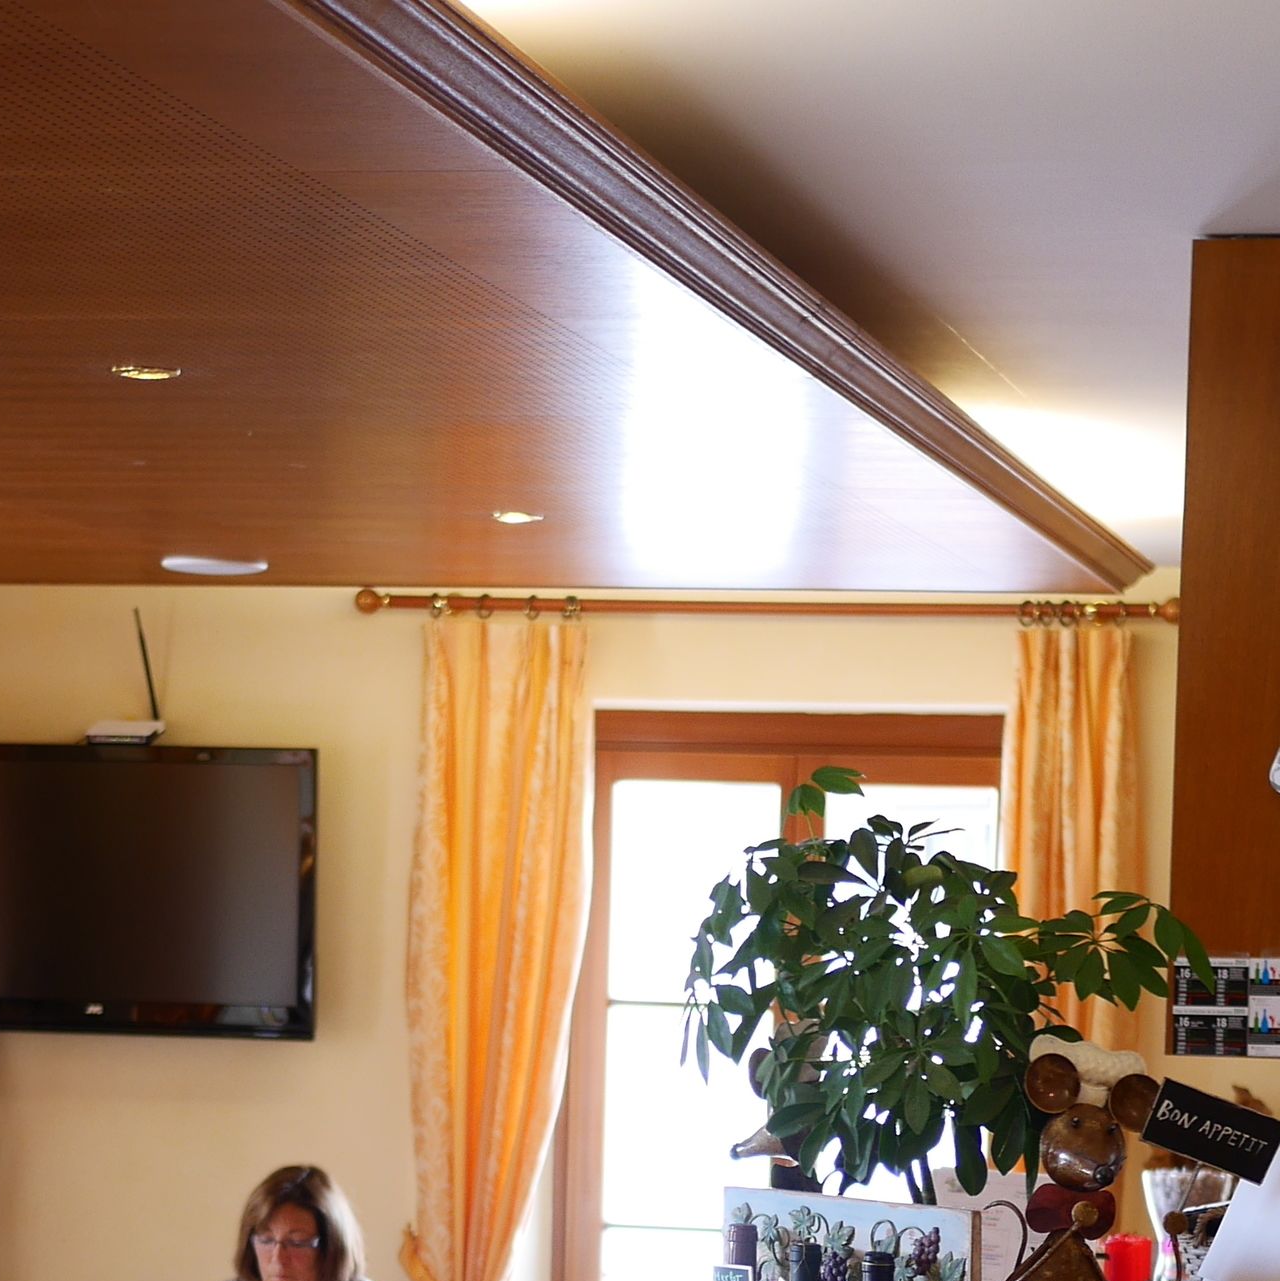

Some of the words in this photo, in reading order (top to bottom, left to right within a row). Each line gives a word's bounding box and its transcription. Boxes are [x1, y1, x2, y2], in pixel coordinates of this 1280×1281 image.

[1180, 968, 1191, 978] 16
[1217, 969, 1229, 979] 18
[1179, 1017, 1190, 1027] 16
[1216, 1018, 1228, 1028] 18
[1157, 1100, 1198, 1128] BON
[1198, 1120, 1268, 1154] APPETIT
